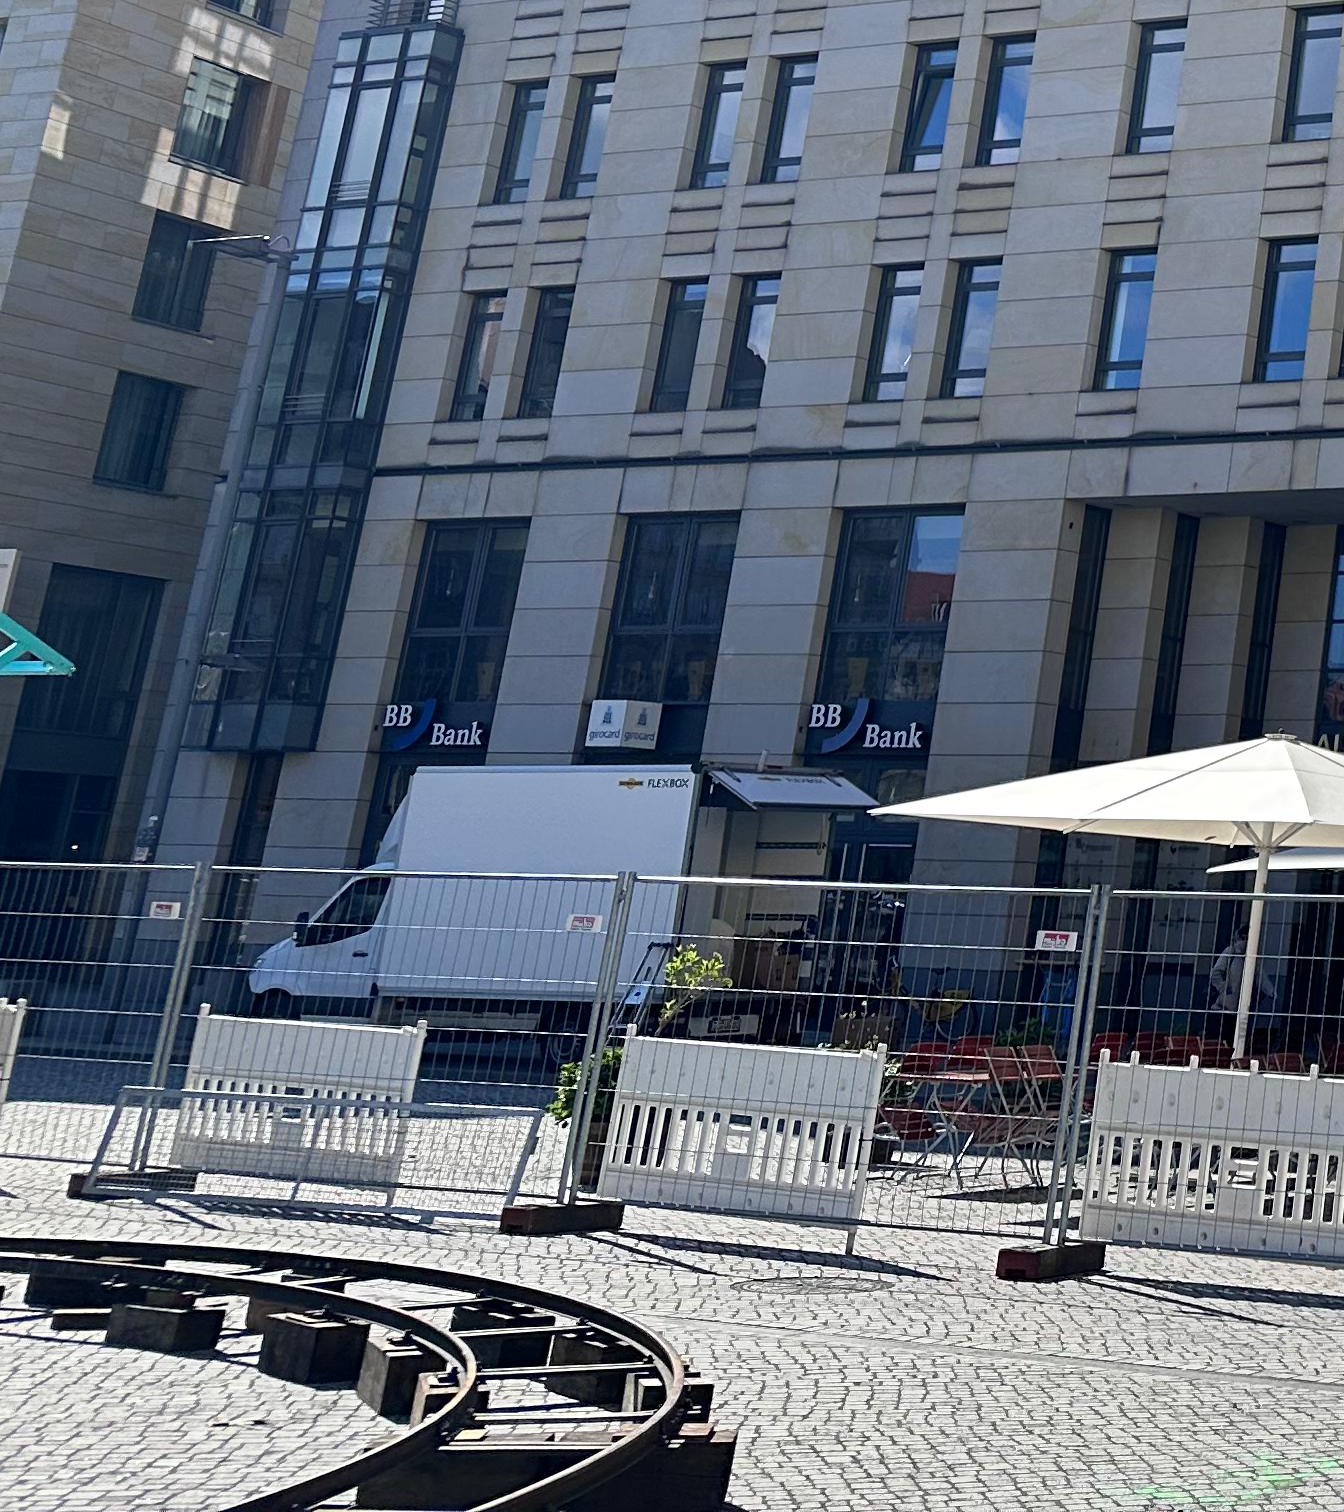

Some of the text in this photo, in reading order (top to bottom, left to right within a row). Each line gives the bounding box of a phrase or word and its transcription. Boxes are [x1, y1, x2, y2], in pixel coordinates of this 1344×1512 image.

[383, 704, 413, 727] BB
[809, 703, 842, 728] BB
[430, 721, 484, 746] Bank
[588, 728, 621, 741] girocard
[624, 731, 656, 743] girocard
[862, 722, 923, 748] Bank
[647, 778, 690, 789] FLEXBOX
